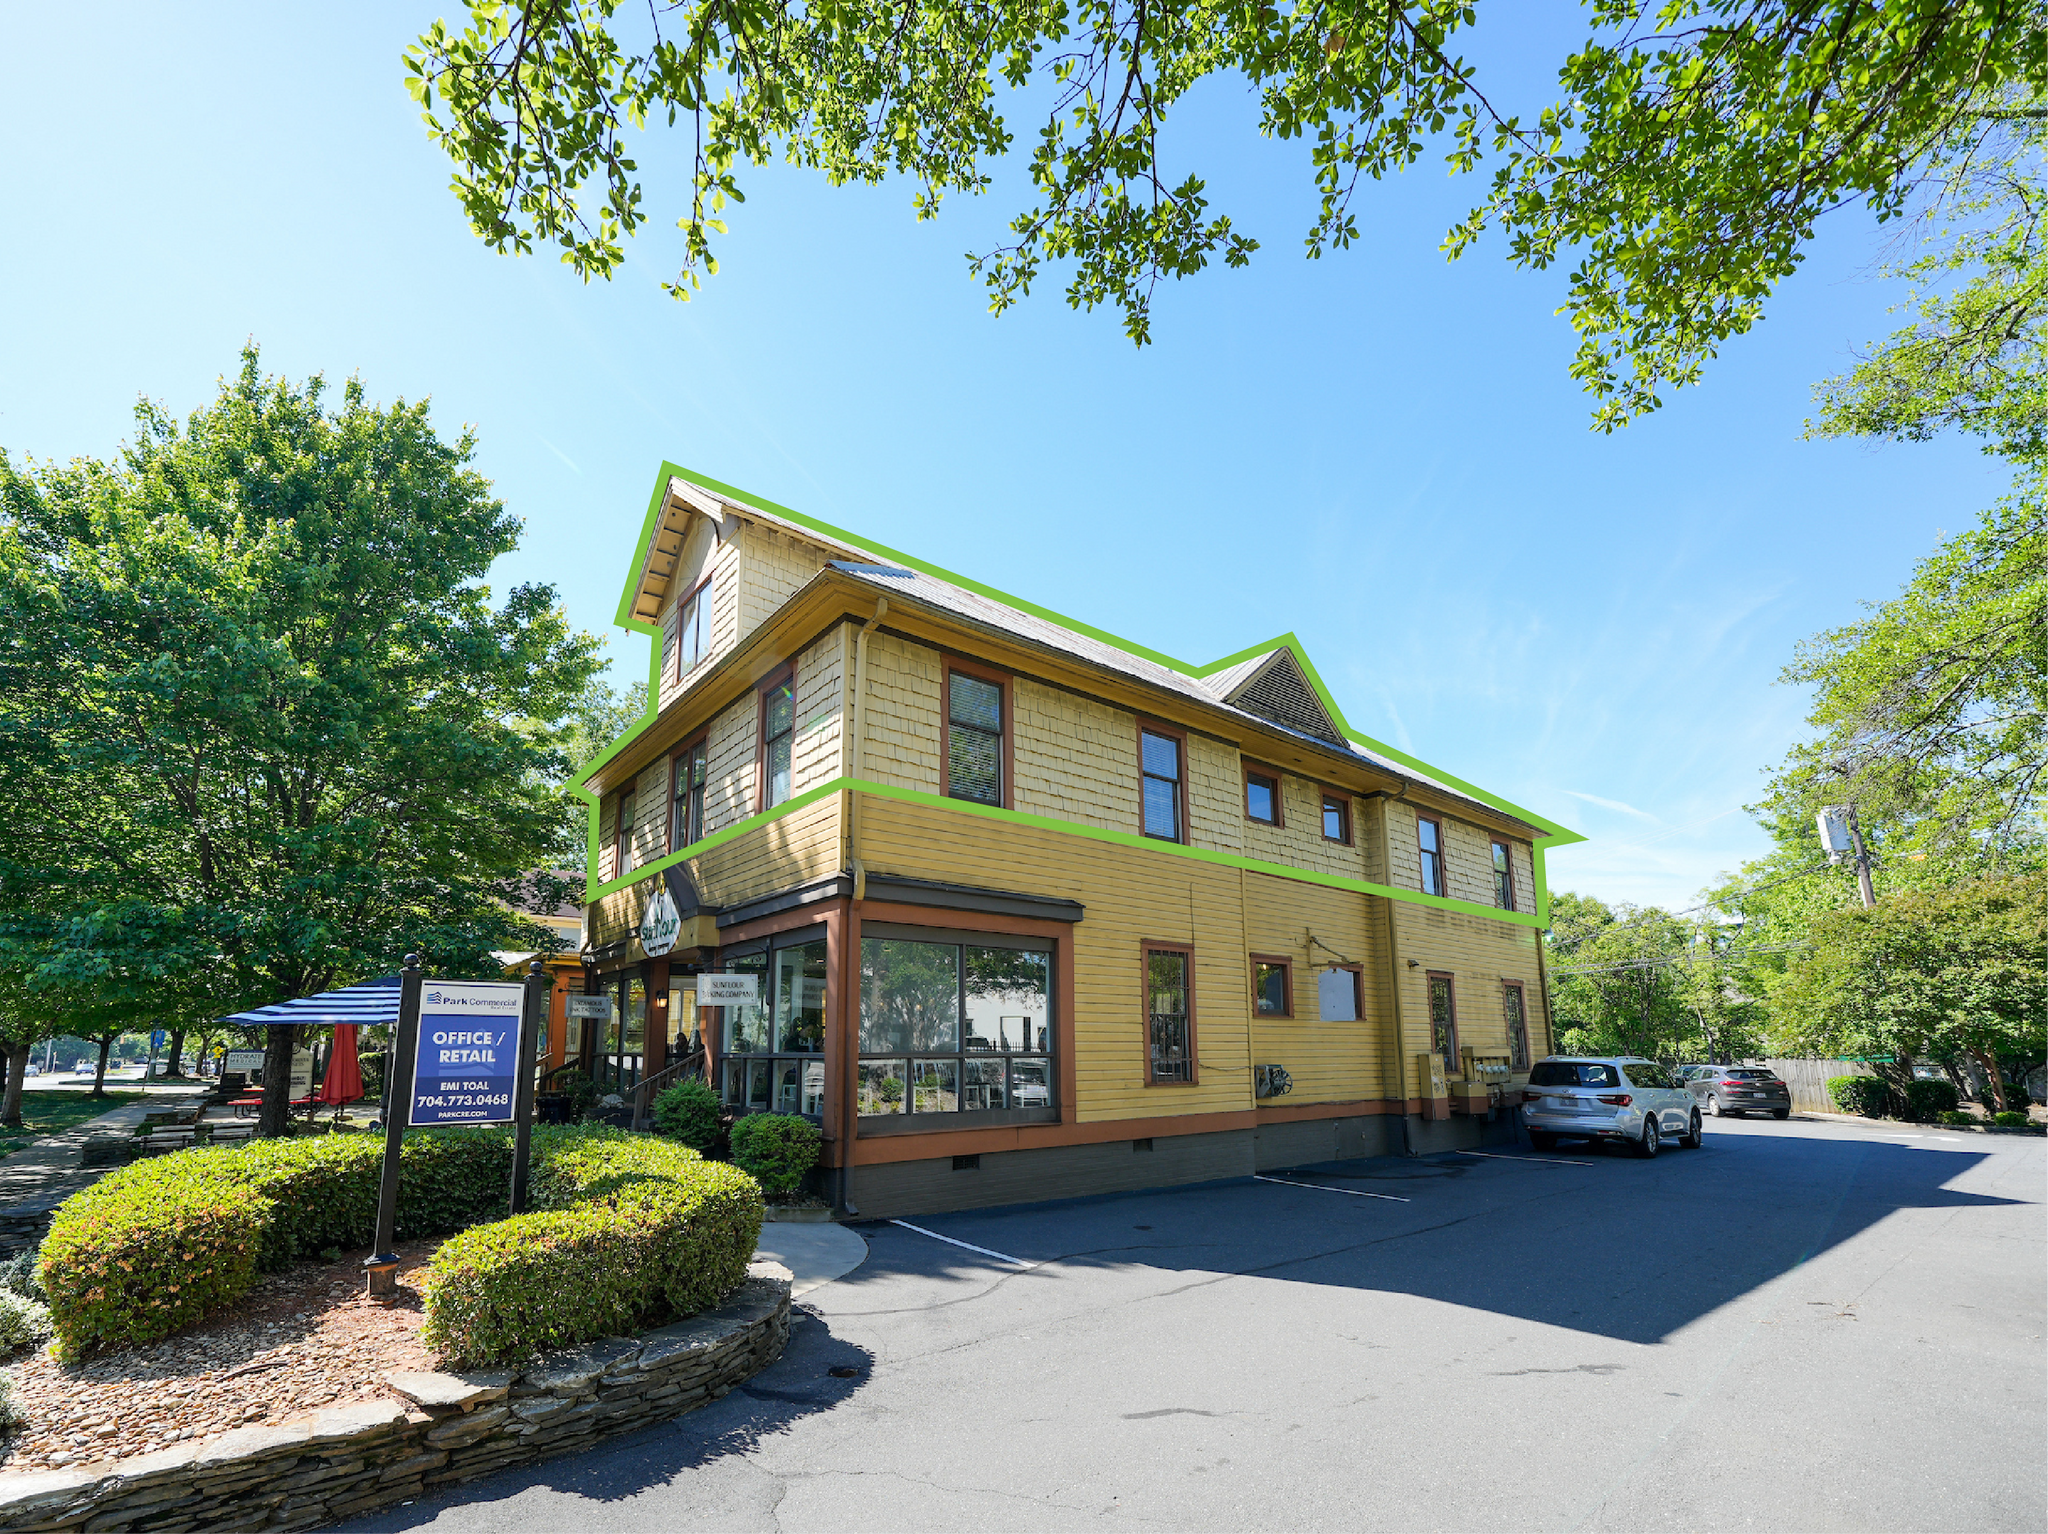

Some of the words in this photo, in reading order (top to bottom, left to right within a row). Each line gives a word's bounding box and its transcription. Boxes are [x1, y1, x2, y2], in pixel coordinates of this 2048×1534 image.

[725, 990, 755, 998] COMPANY
[443, 997, 468, 1005] Park
[469, 997, 517, 1007] Commercial
[432, 1031, 492, 1044] OFFICE
[496, 1032, 506, 1046] /
[439, 1049, 496, 1063] RETAIL
[440, 1082, 460, 1091] EMI
[462, 1081, 489, 1090] TOAL
[417, 1094, 508, 1107] 704.773.0468
[438, 1111, 488, 1119] PARKCRE.COM
